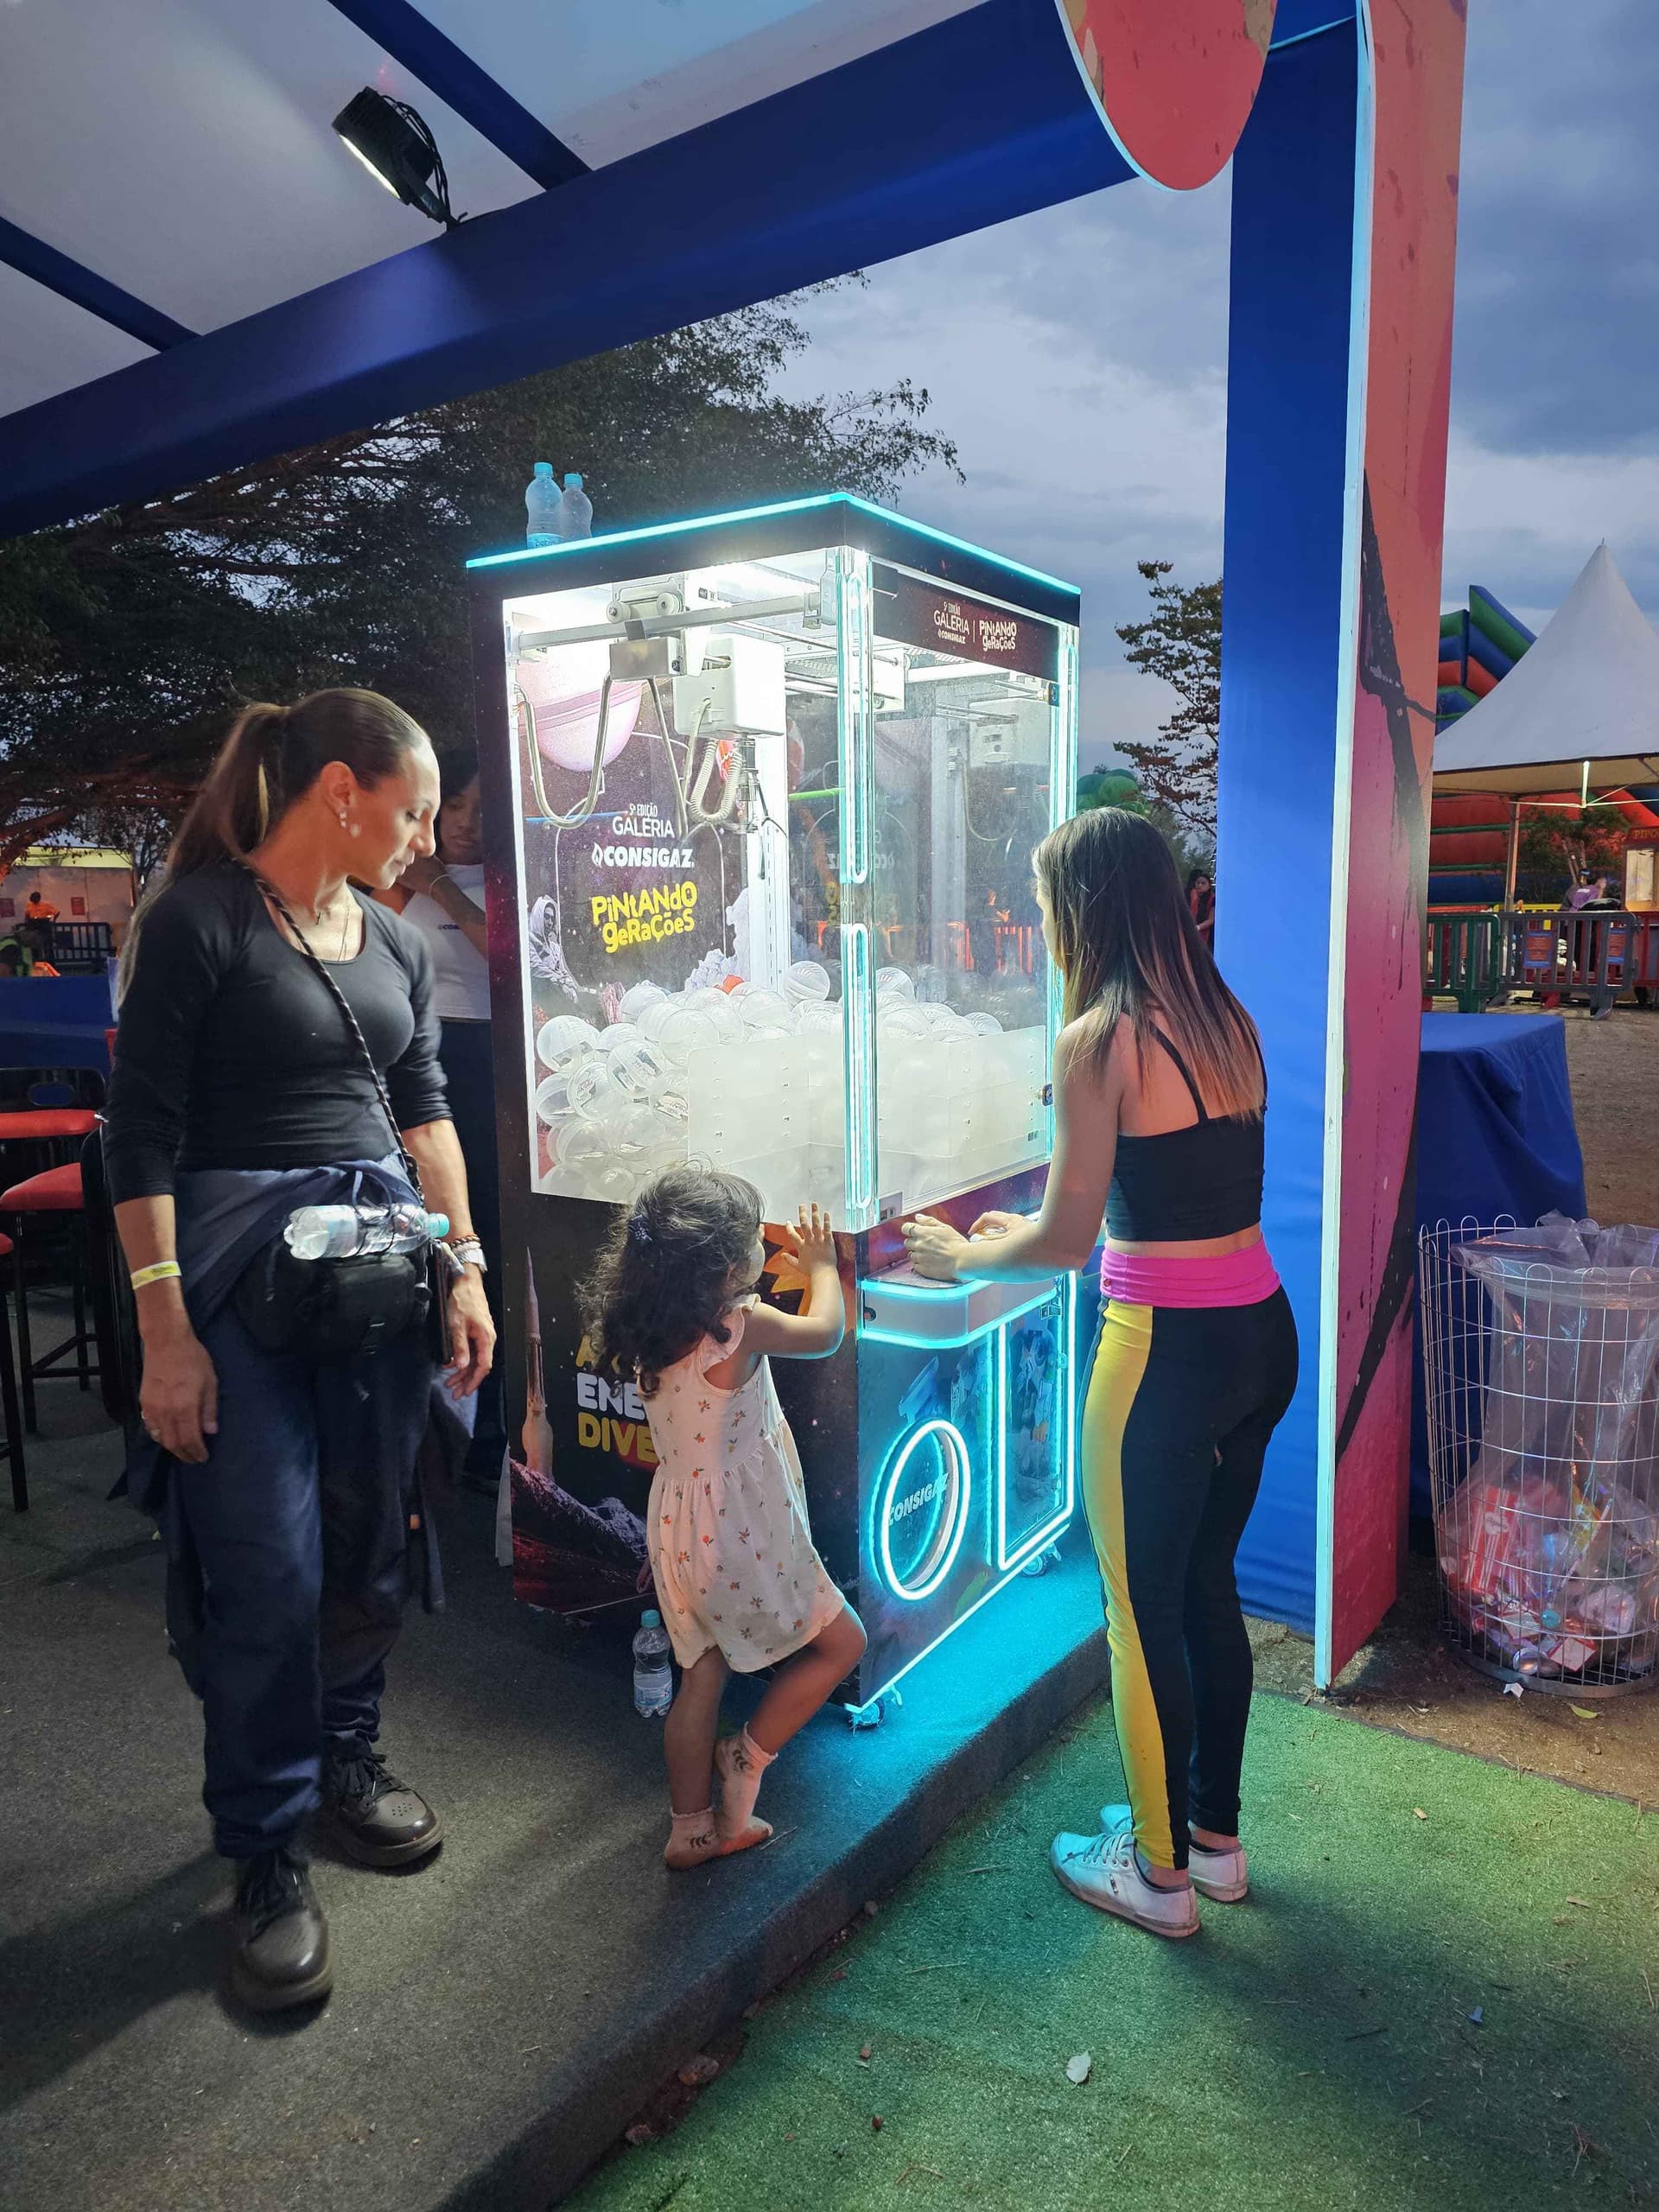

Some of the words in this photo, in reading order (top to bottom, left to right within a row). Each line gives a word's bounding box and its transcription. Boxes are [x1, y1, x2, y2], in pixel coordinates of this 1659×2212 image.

[933, 609, 970, 636] GALERIA
[637, 802, 658, 818] EDIÇÃO
[612, 816, 676, 839] GALERIA
[603, 846, 695, 868] CONSIGAZ
[577, 1372, 645, 1420] ENE
[578, 1412, 659, 1464] DIVE
